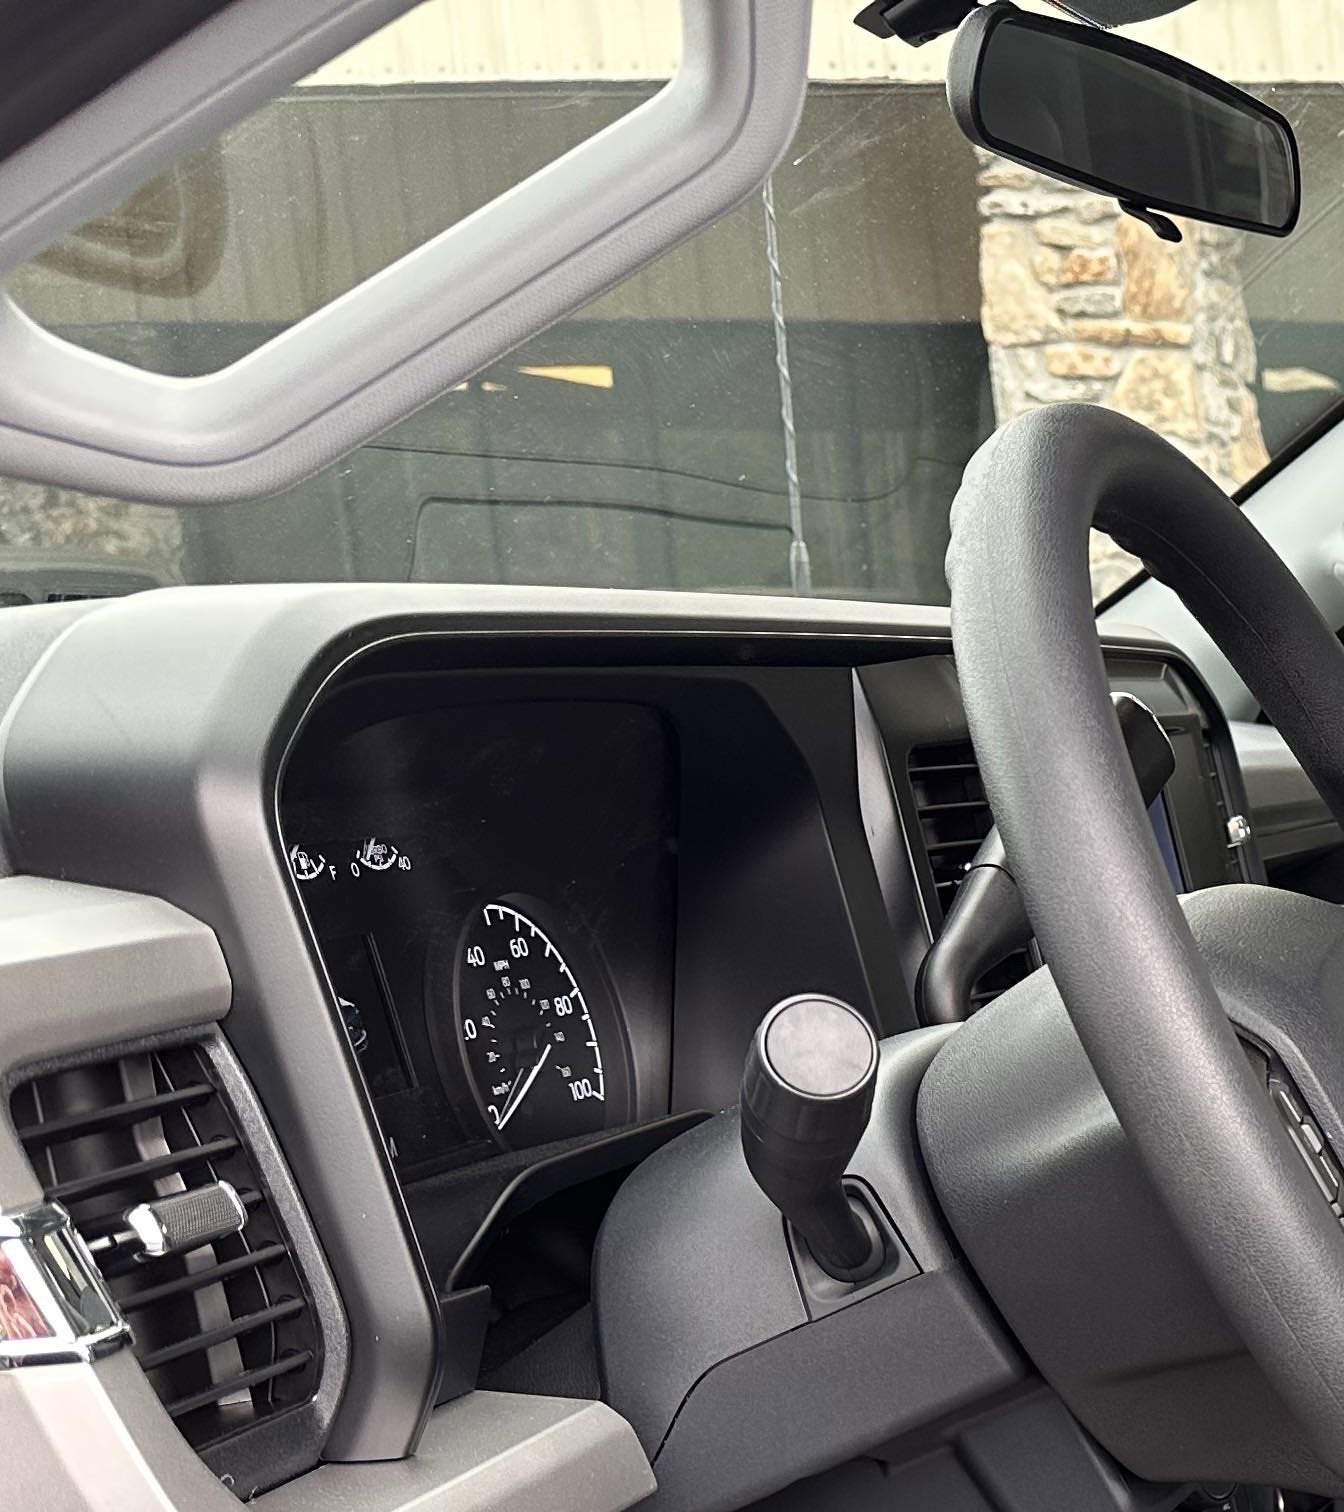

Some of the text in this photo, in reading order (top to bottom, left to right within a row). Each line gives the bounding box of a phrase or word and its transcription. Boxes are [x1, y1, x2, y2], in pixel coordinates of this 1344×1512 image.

[329, 865, 337, 881] F
[350, 861, 360, 878] 0
[398, 855, 412, 871] 40
[466, 945, 486, 967] 40
[509, 937, 530, 958] 60
[553, 995, 573, 1017] 80
[463, 1018, 478, 1041] 0
[568, 1078, 594, 1101] 100
